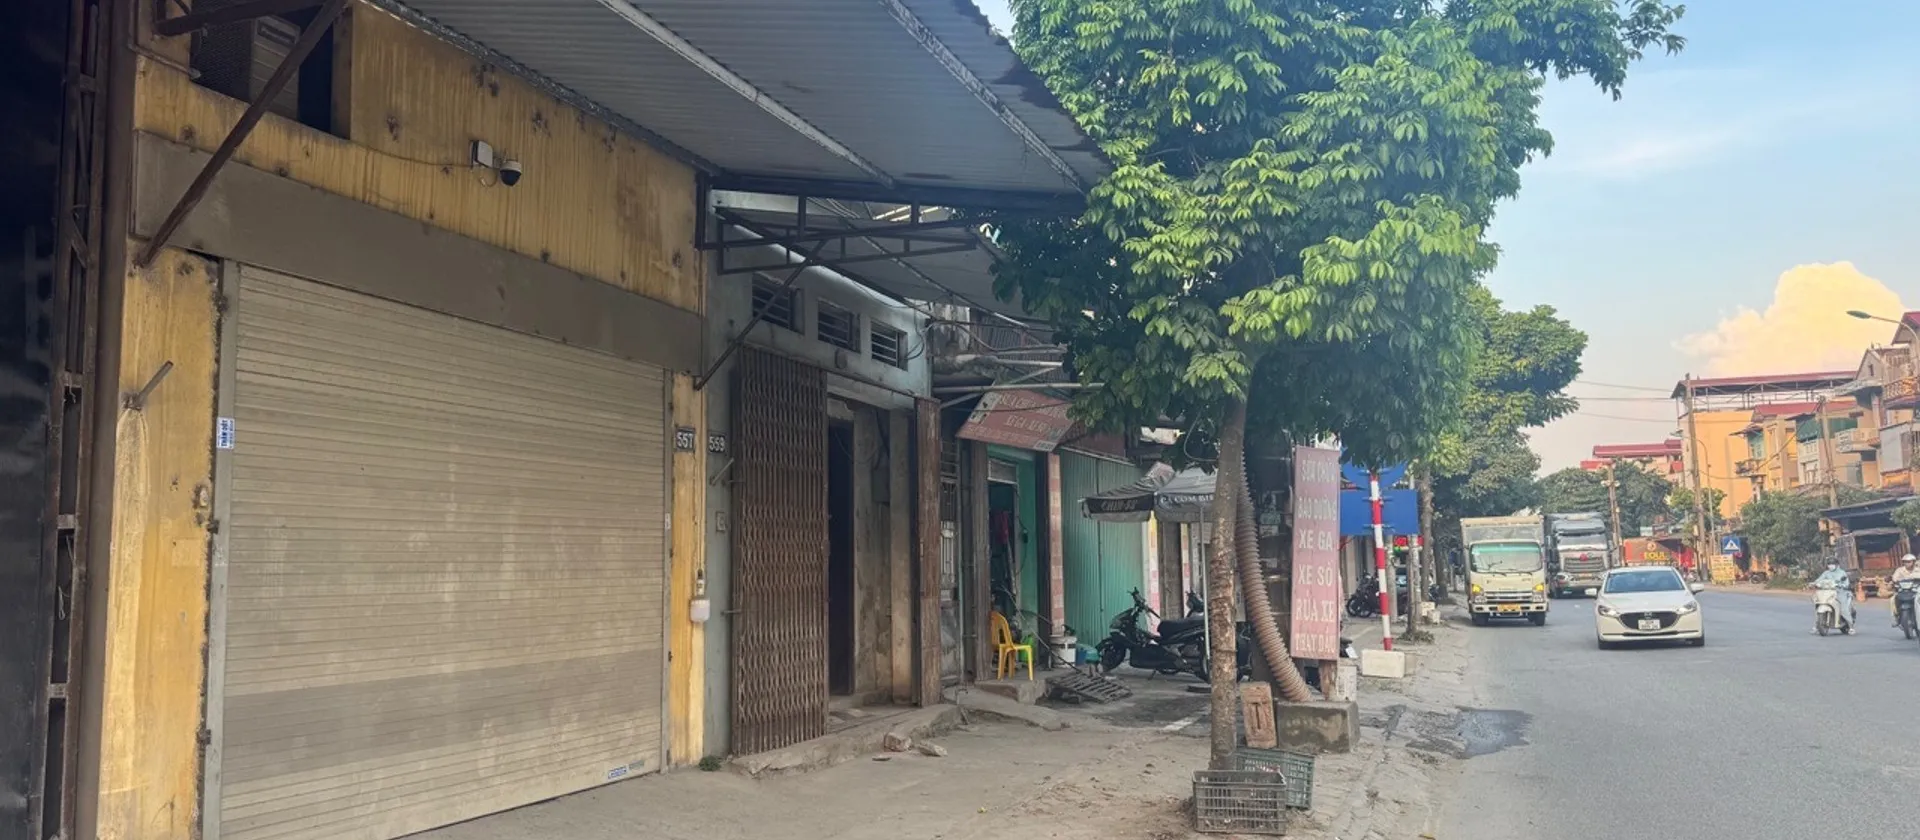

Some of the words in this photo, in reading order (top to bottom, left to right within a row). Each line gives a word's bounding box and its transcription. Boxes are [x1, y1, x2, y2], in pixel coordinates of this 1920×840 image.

[677, 431, 693, 448] 557
[710, 436, 725, 451] 559
[1299, 528, 1314, 549] XE
[1318, 530, 1333, 552] GA
[1298, 563, 1313, 585] XE
[1321, 600, 1335, 622] XE
